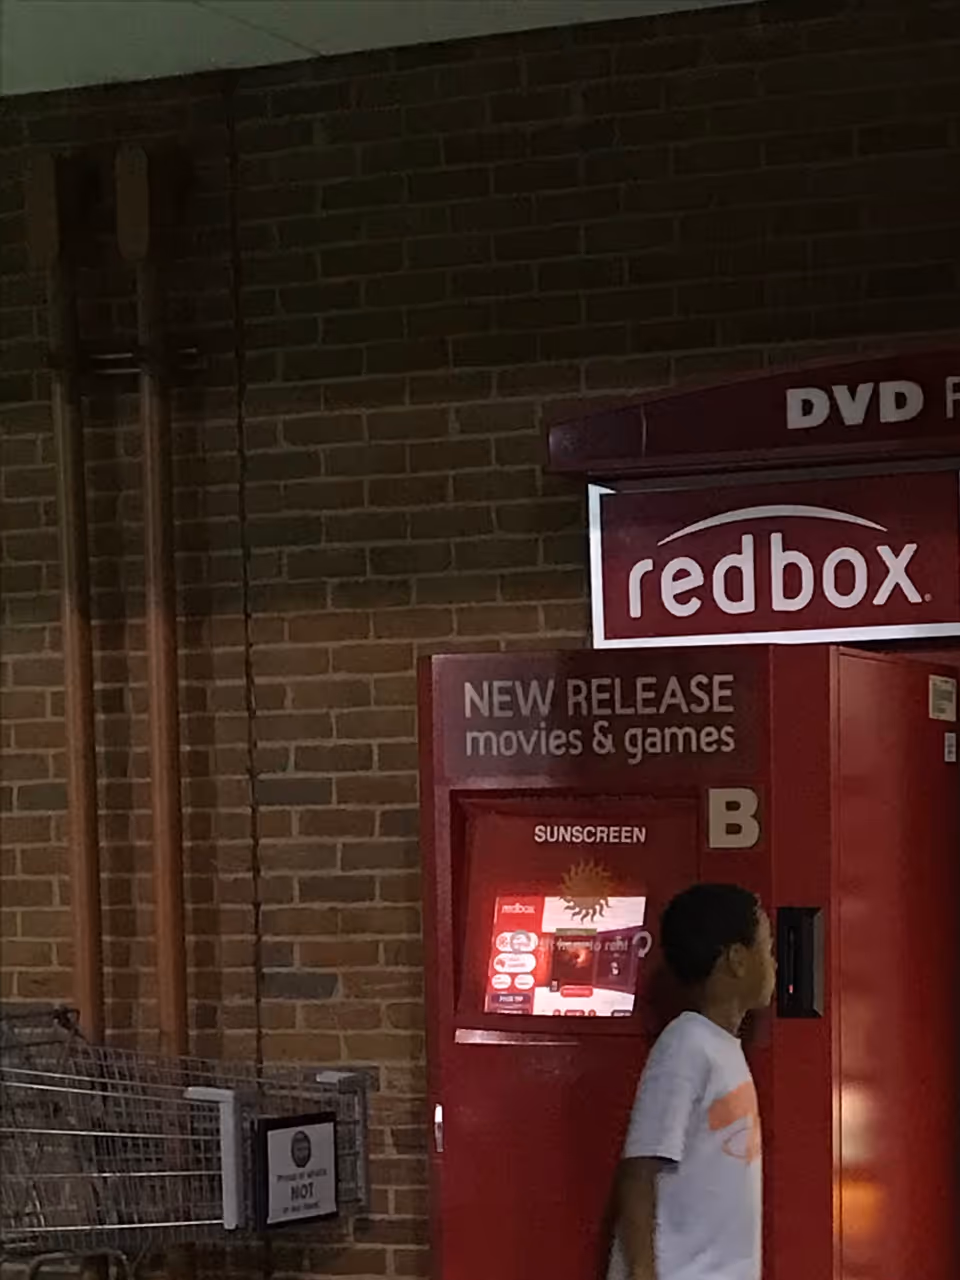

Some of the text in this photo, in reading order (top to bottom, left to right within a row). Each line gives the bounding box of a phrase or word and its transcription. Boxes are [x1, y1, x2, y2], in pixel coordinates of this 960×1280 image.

[786, 380, 924, 430] DVD
[629, 532, 922, 618] redbox
[464, 674, 734, 718] NEW RELEASE
[466, 720, 736, 765] movies & games
[534, 825, 646, 843] SUNSCREEN
[708, 787, 761, 849] B
[290, 1181, 314, 1202] NOT
